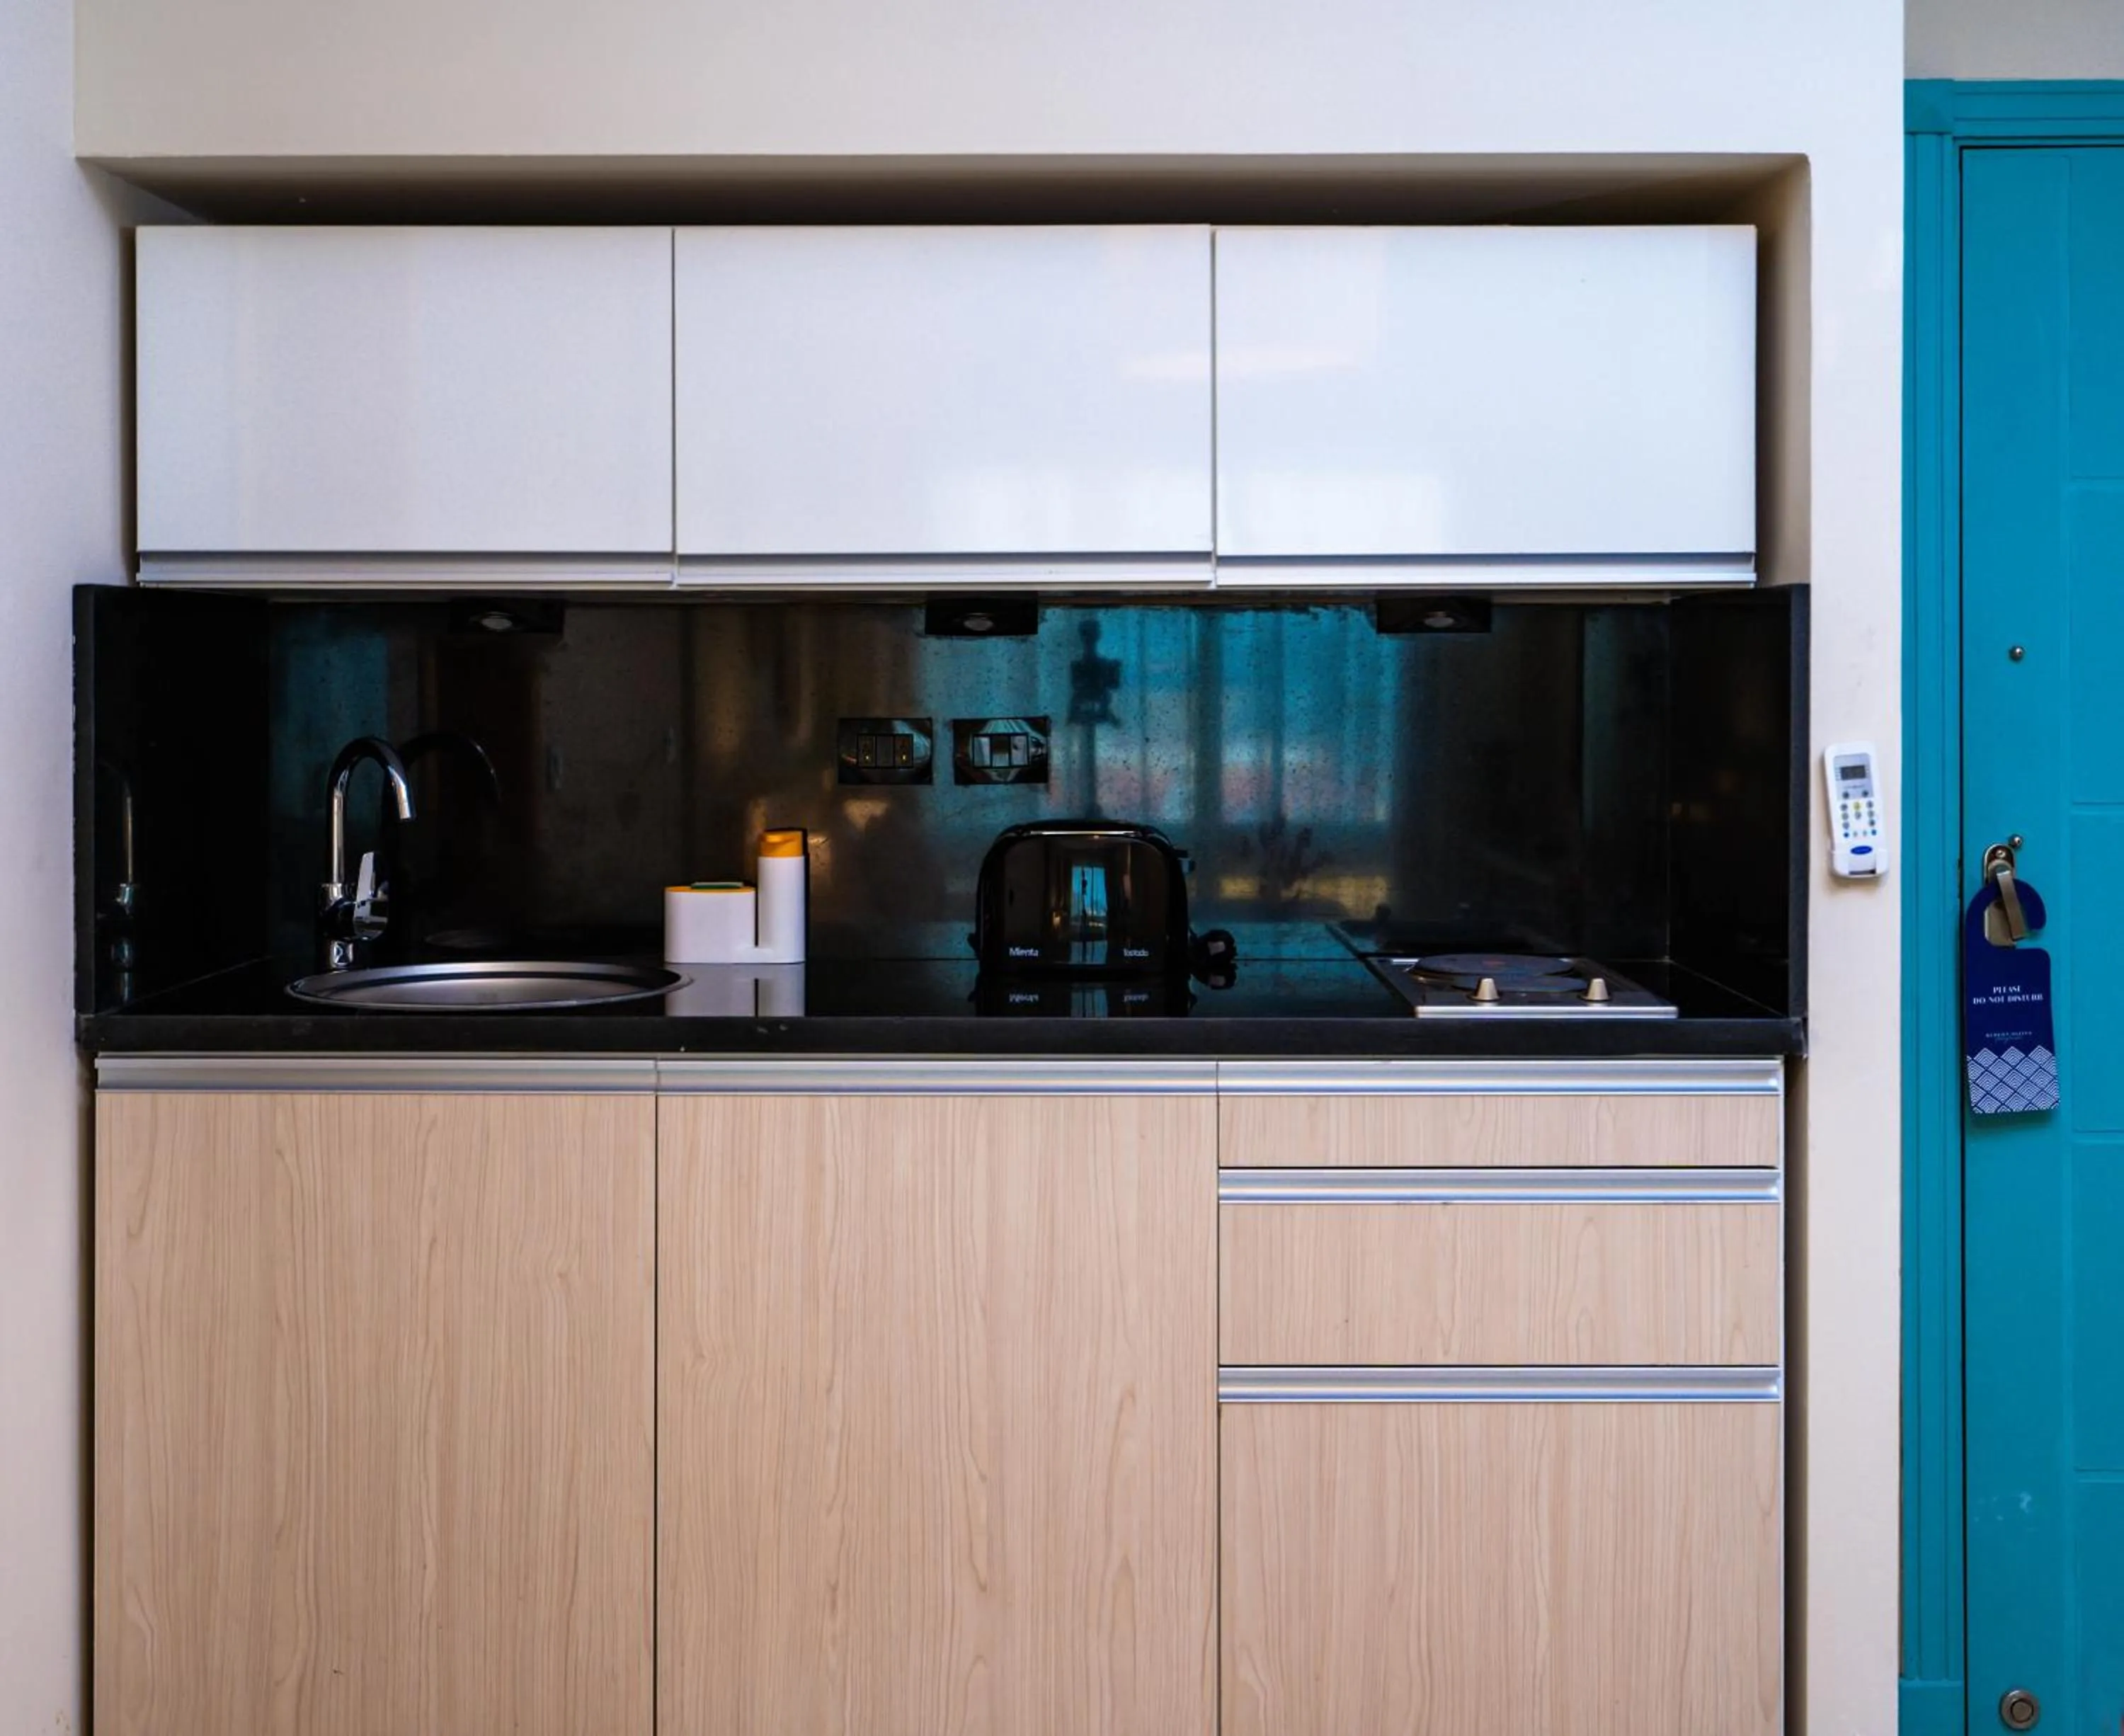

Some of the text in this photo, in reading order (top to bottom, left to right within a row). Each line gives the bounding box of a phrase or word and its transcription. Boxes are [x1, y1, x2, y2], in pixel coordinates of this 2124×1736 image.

[1993, 985, 2021, 993] PLEASE
[1988, 995, 2004, 1004] NOT
[2007, 993, 2043, 1003] DISTURB
